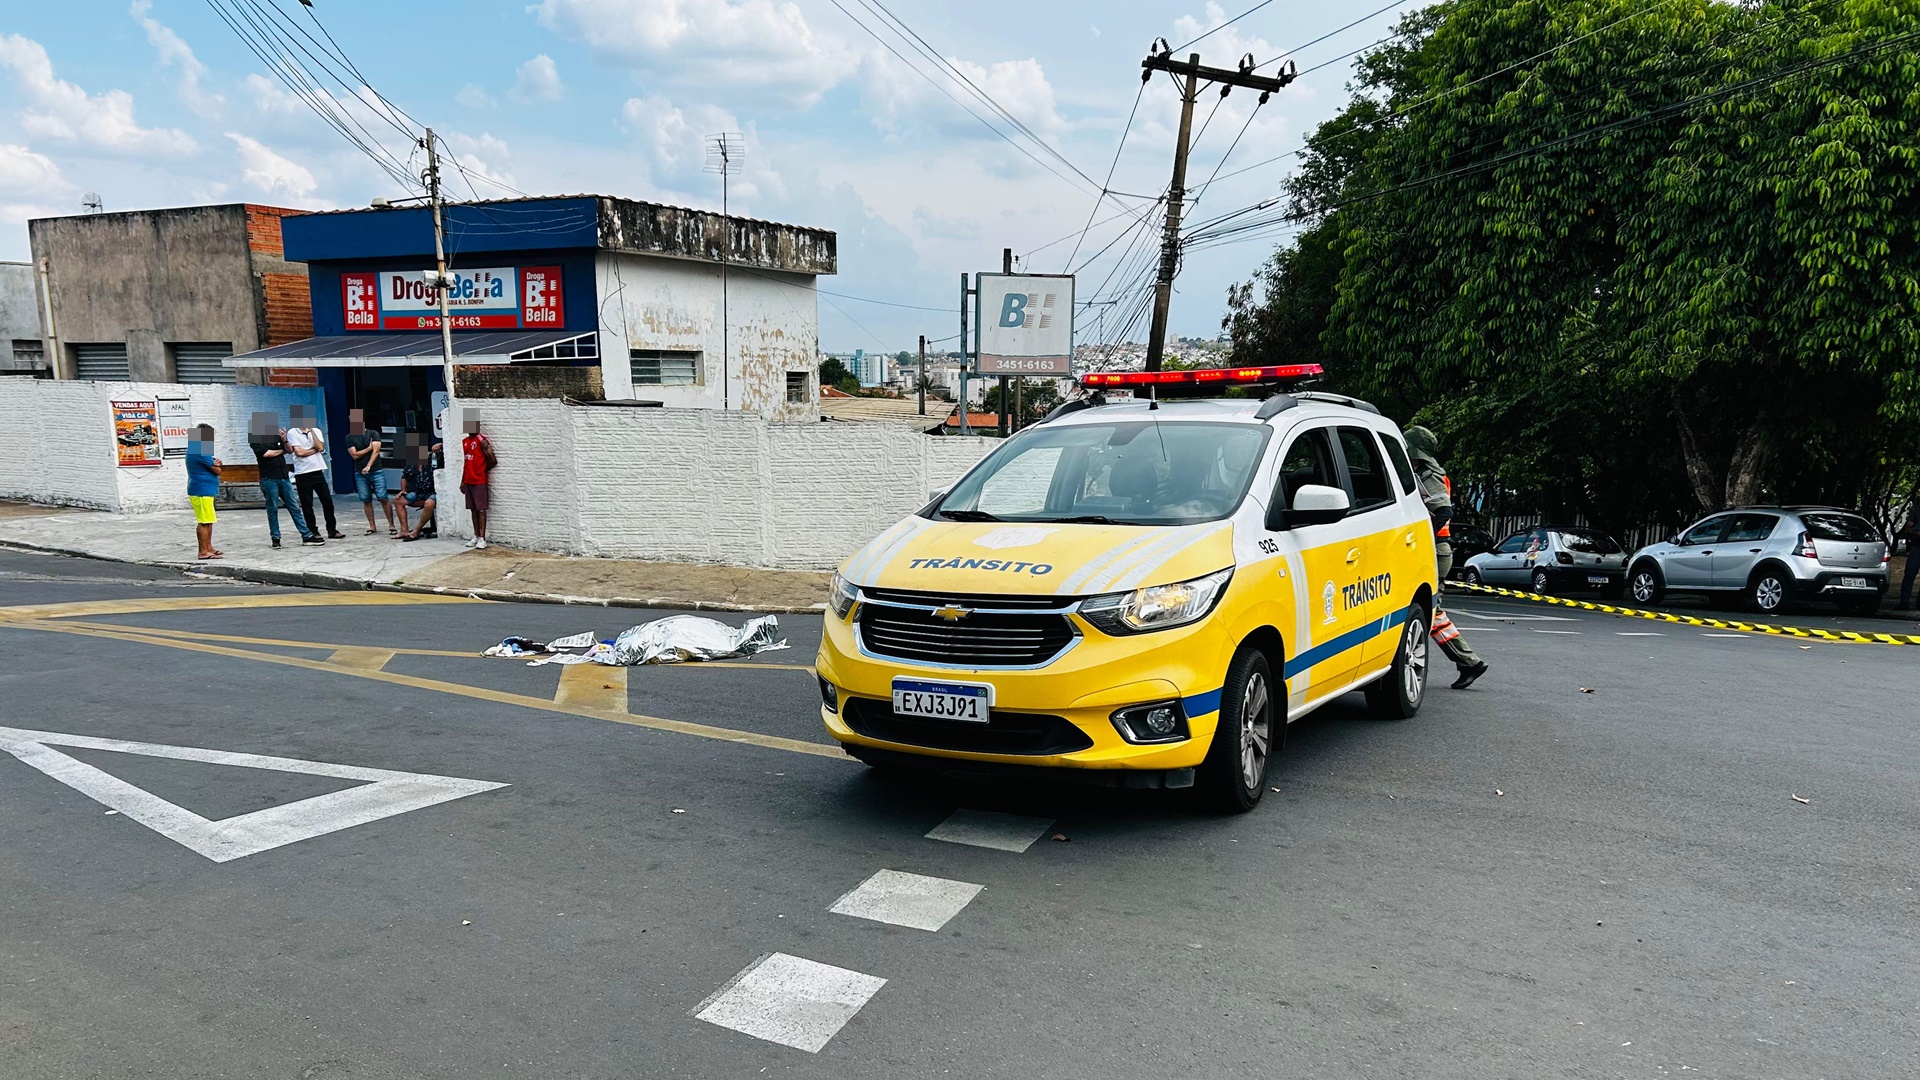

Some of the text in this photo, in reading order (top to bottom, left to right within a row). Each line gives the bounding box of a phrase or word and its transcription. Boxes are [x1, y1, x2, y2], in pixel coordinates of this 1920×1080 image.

[347, 277, 363, 286] Droga
[526, 272, 545, 280] Droga
[347, 311, 374, 324] Bella
[526, 307, 556, 322] Bella
[996, 360, 1055, 370] 3451-6163
[1258, 538, 1279, 554] 925
[909, 557, 1053, 575] TRÂNSITO
[1342, 572, 1391, 611] TRÂNSITO
[902, 692, 978, 719] EXJ3J91
